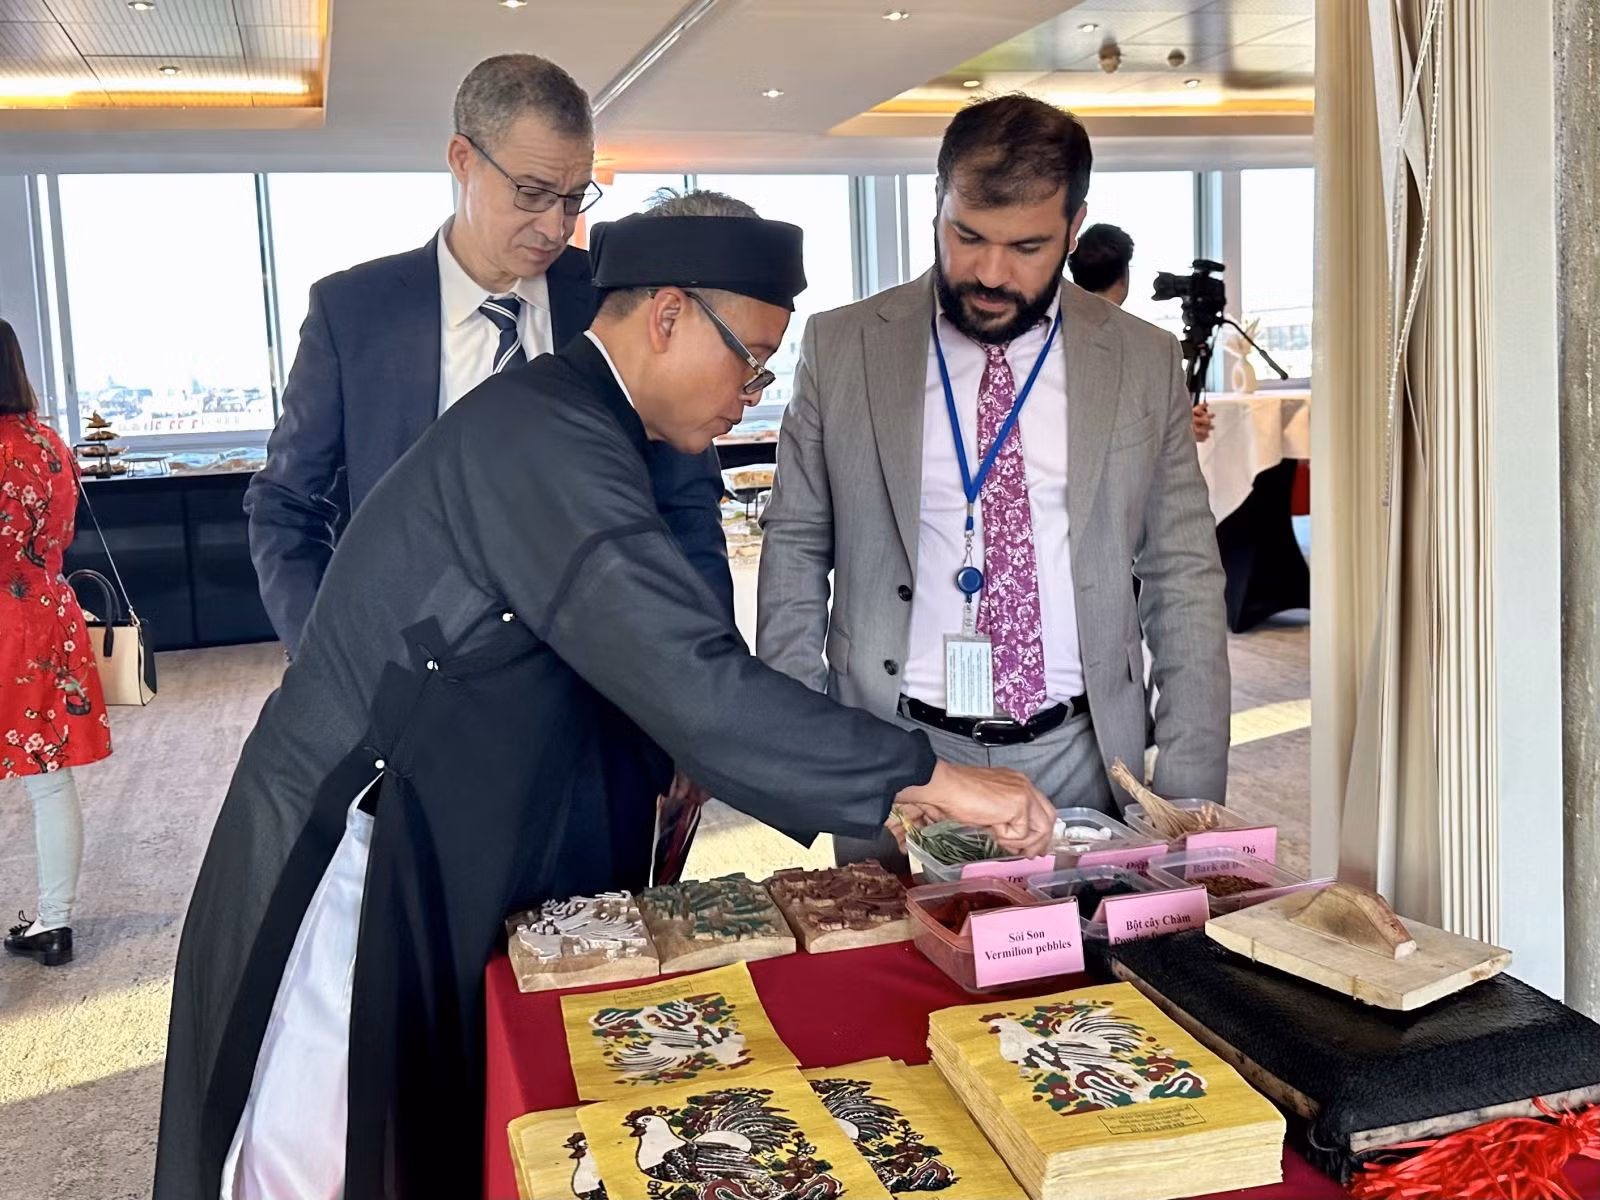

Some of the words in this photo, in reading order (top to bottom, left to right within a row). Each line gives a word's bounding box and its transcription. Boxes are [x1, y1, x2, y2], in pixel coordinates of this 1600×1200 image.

[1125, 919, 1143, 932] Bột
[1144, 916, 1160, 930] cây
[1026, 929, 1045, 941] Son
[984, 946, 1033, 961] Vermilion
[1035, 939, 1072, 956] pebbles
